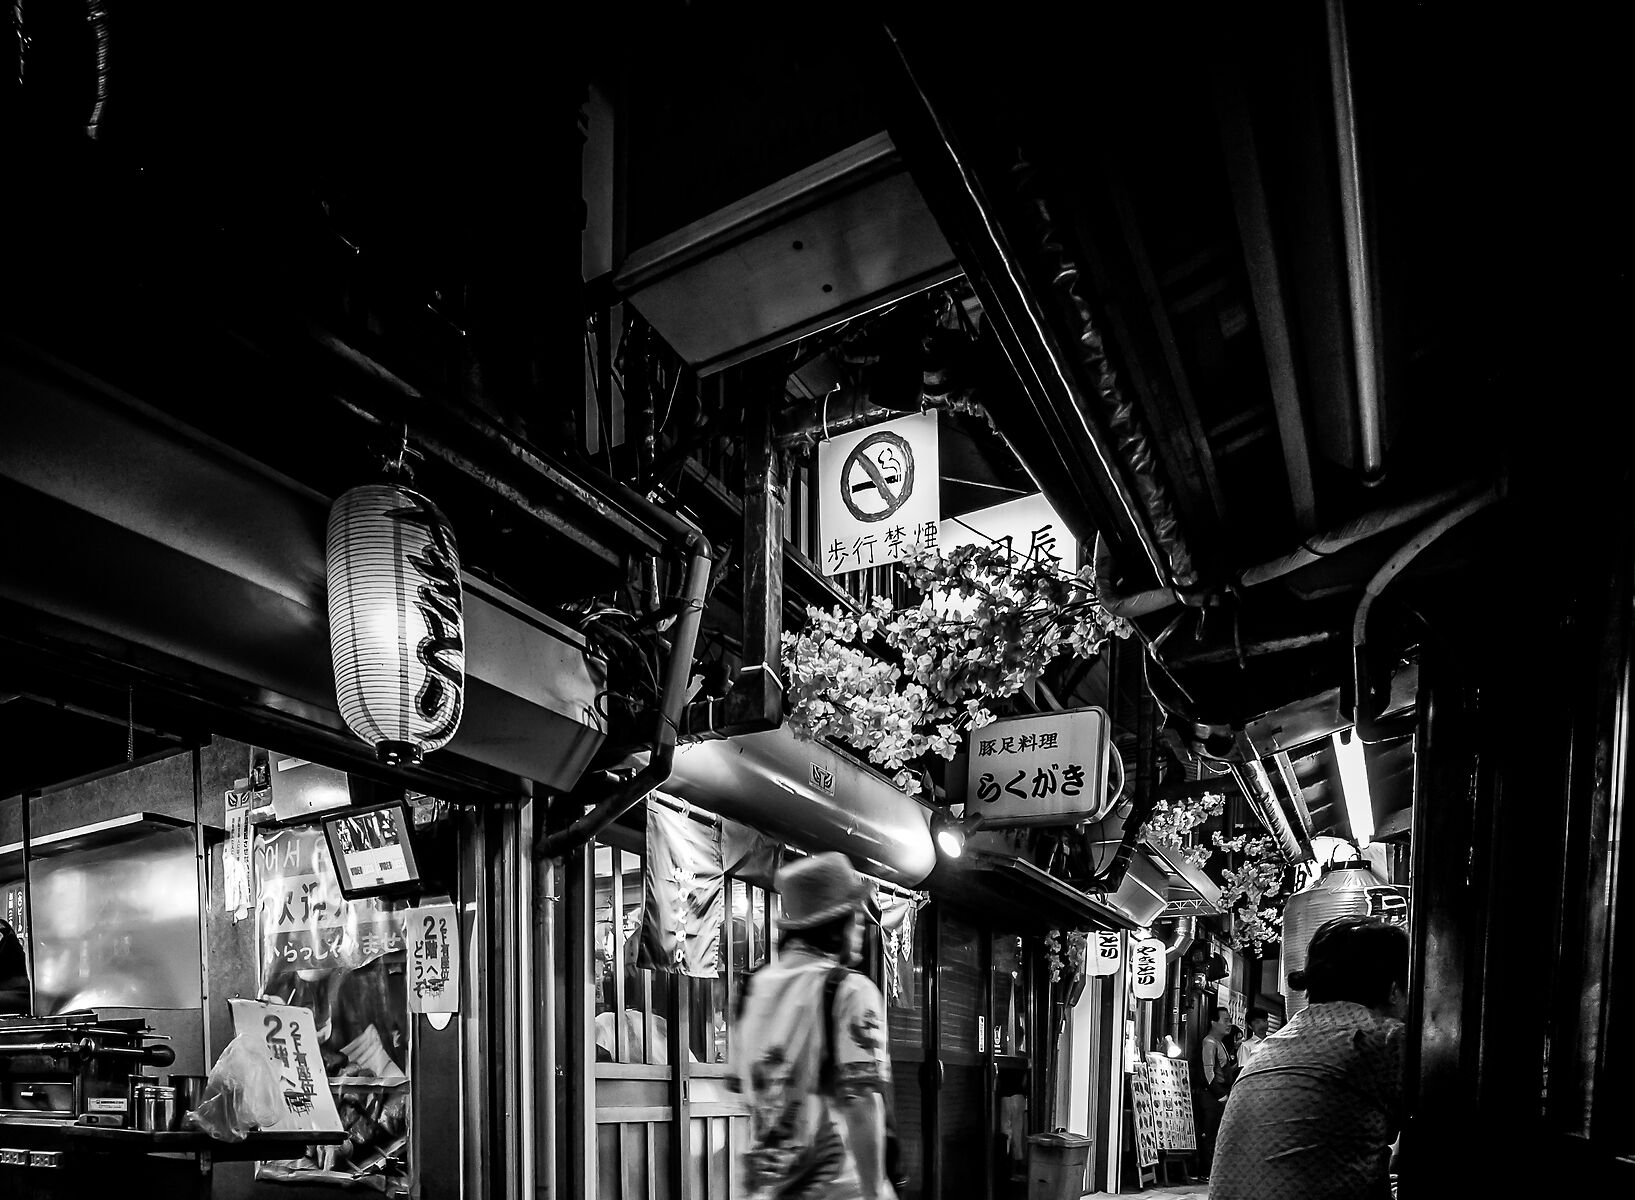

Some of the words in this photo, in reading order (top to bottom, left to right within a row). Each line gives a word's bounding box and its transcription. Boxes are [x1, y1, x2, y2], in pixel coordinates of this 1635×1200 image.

[828, 520, 939, 573] 歩行禁煙
[978, 732, 1059, 757] 豚足料理
[976, 763, 1086, 803] らくがき
